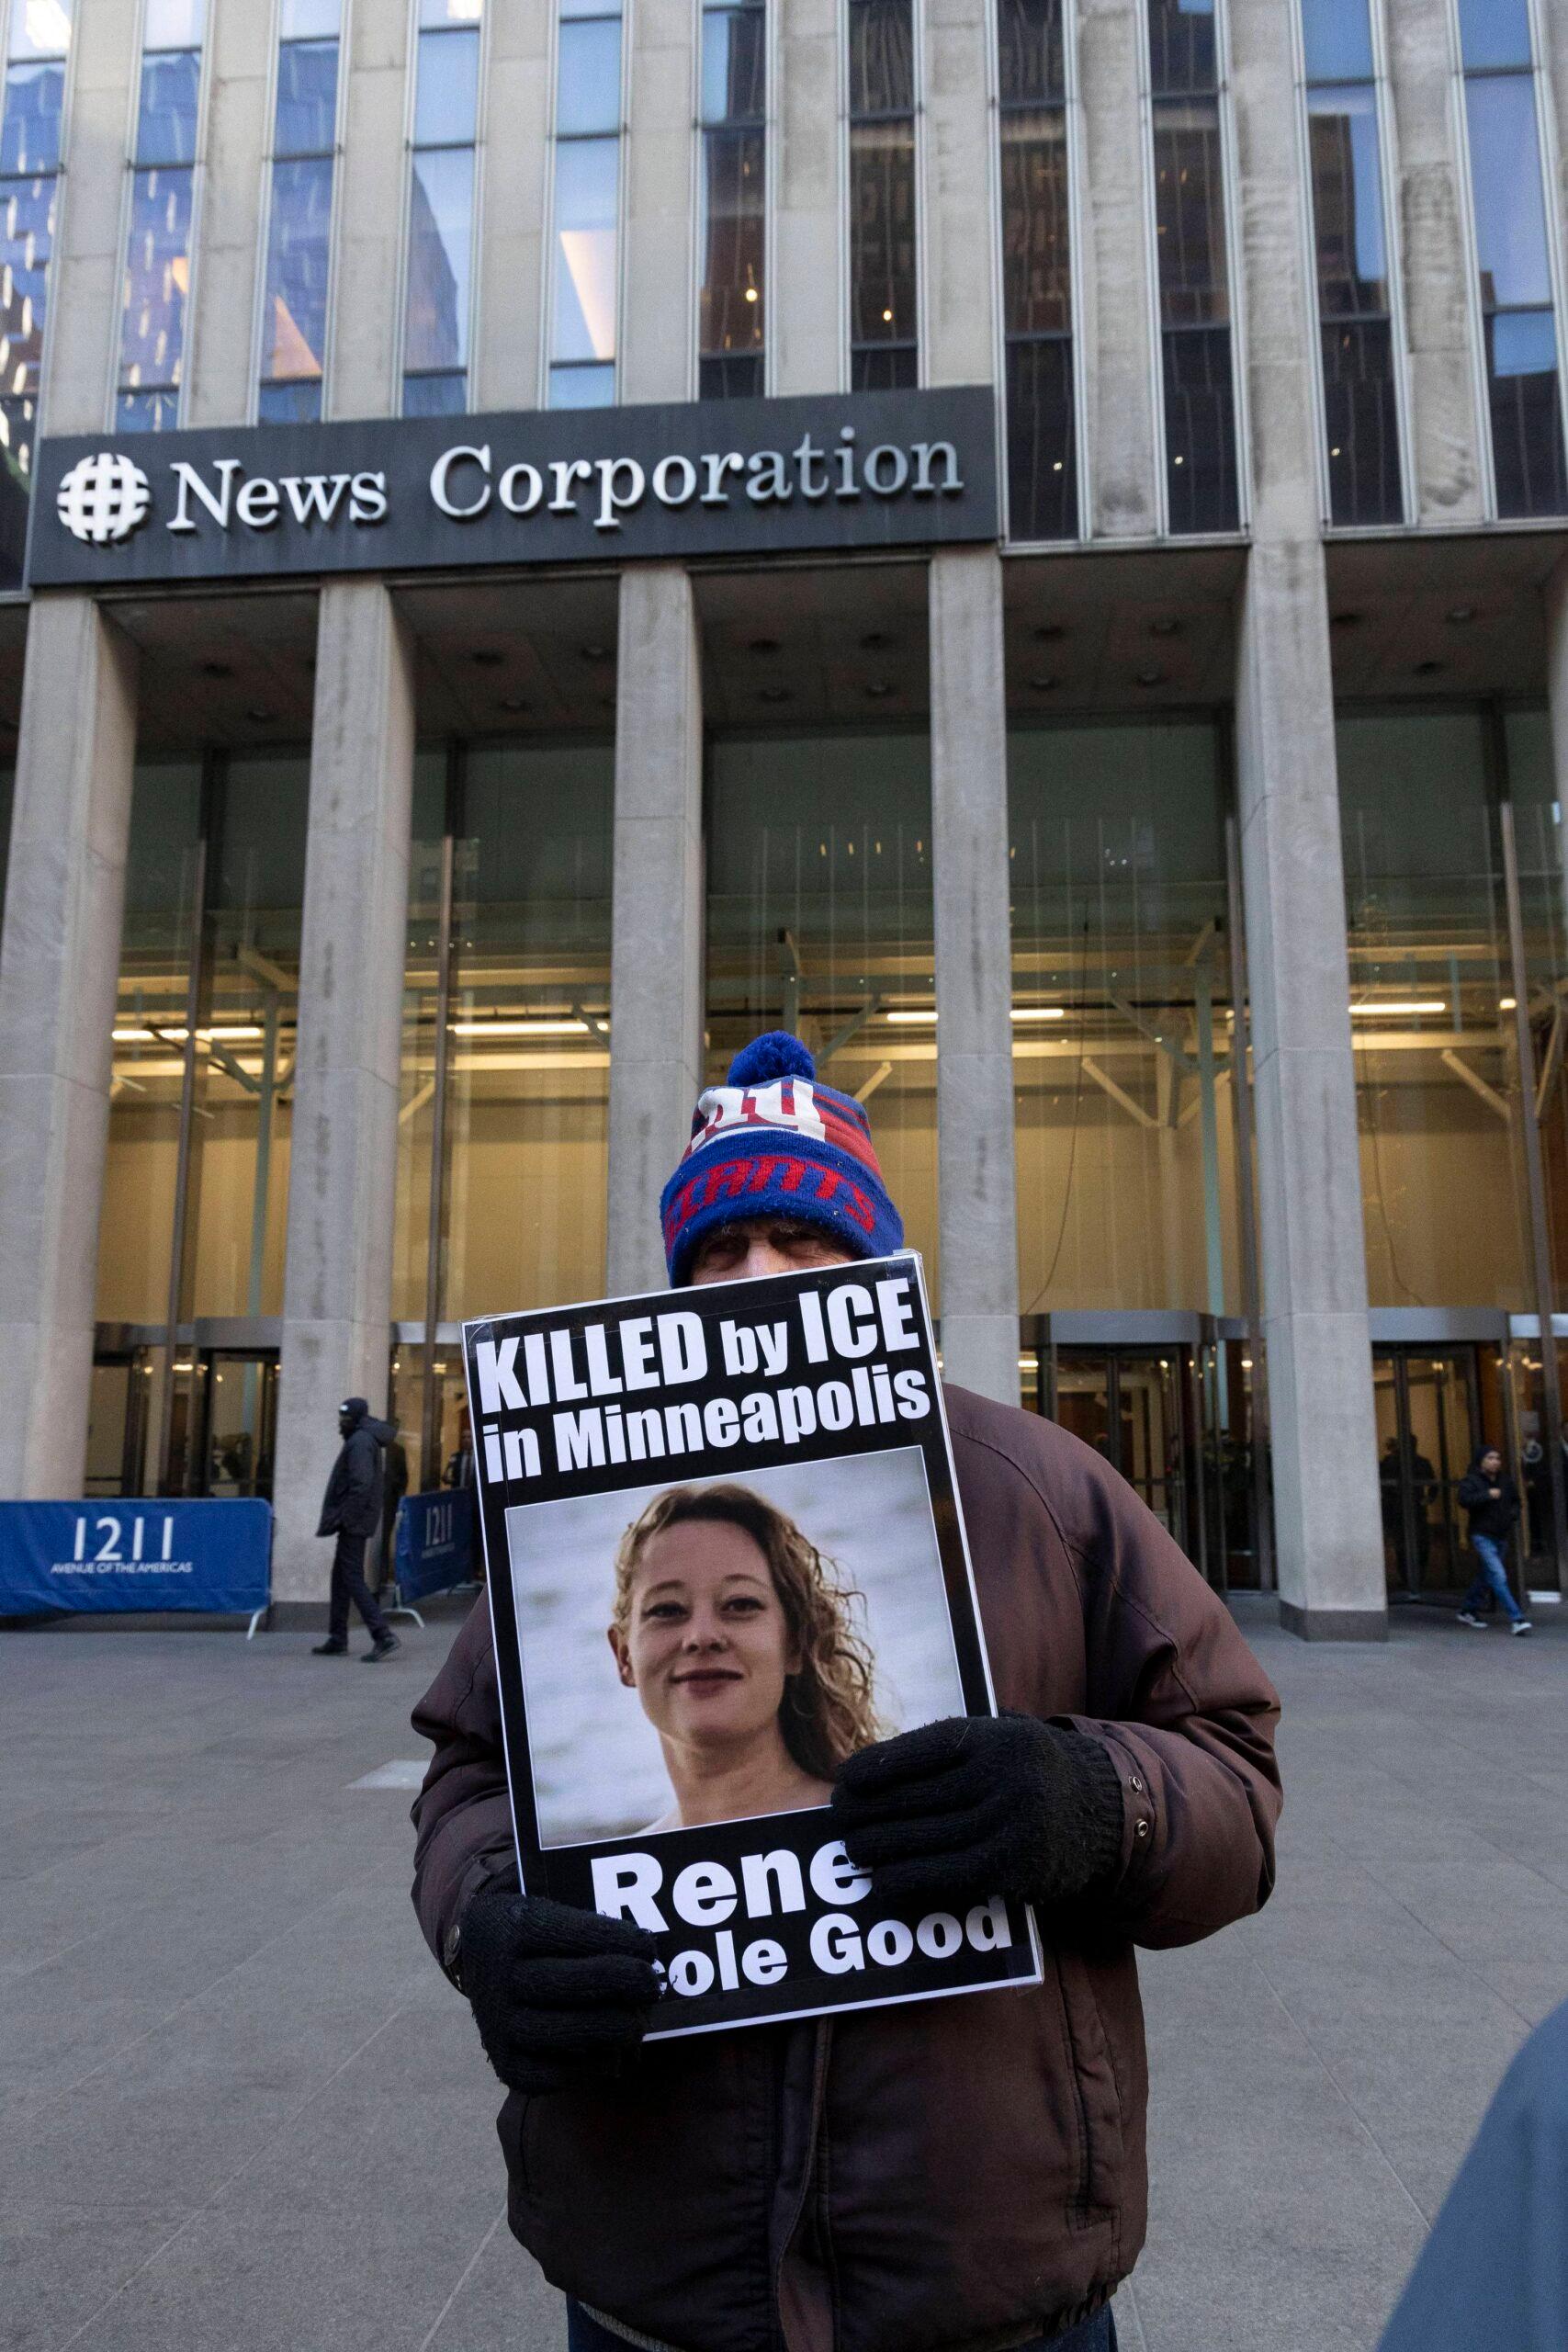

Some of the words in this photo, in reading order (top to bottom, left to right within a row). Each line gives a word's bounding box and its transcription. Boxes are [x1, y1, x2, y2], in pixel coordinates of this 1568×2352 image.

[168, 458, 388, 533] News
[429, 425, 964, 528] Corporation
[476, 1311, 708, 1414] KILLED
[720, 1319, 788, 1376] by
[798, 1278, 920, 1363] ICE
[482, 1424, 543, 1484] in
[552, 1363, 931, 1473] Minneapolis
[73, 1517, 174, 1561] 1211
[651, 1929, 788, 1997] ole
[810, 1894, 1012, 1975] Good
